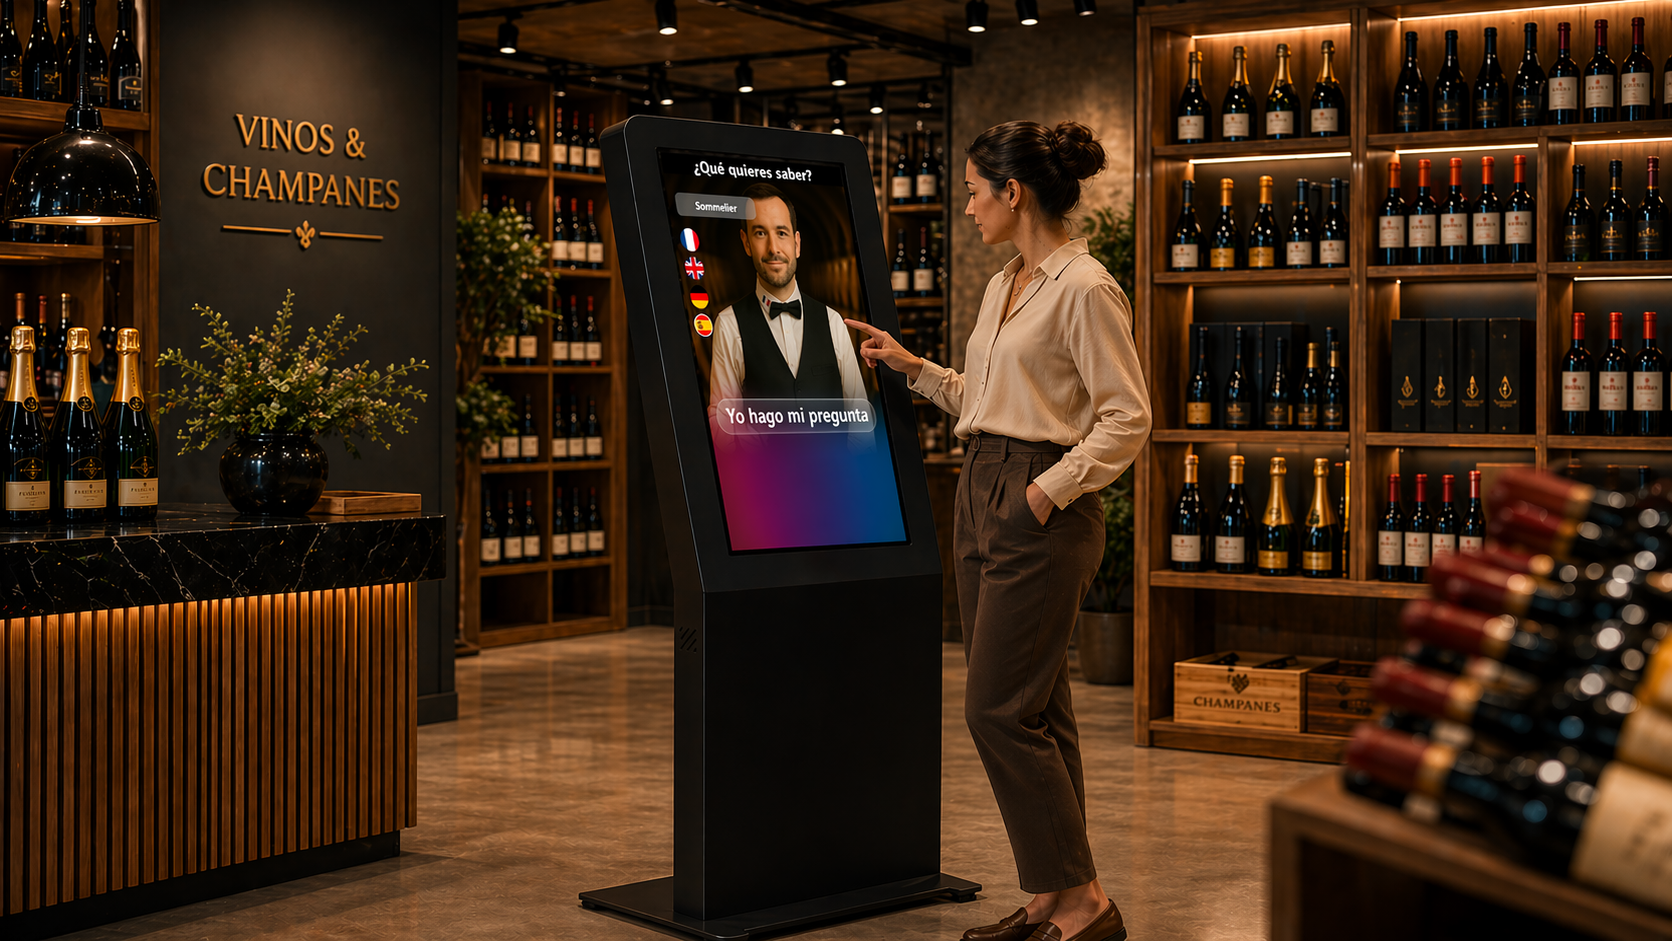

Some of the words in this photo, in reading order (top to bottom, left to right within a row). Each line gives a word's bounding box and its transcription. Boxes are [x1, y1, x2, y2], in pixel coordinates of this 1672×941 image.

[234, 113, 335, 155] VINOS
[345, 127, 367, 159] &
[693, 161, 725, 177] ¿Qué
[728, 164, 773, 178] quieres
[775, 168, 812, 182] saber?
[201, 162, 400, 210] CHAMPANES
[695, 201, 738, 213] Sommelier
[725, 407, 745, 424] Yo
[748, 407, 784, 428] hago
[787, 407, 805, 423] mi
[808, 408, 869, 428] pregunta
[1193, 696, 1281, 713] CHAMPANES
